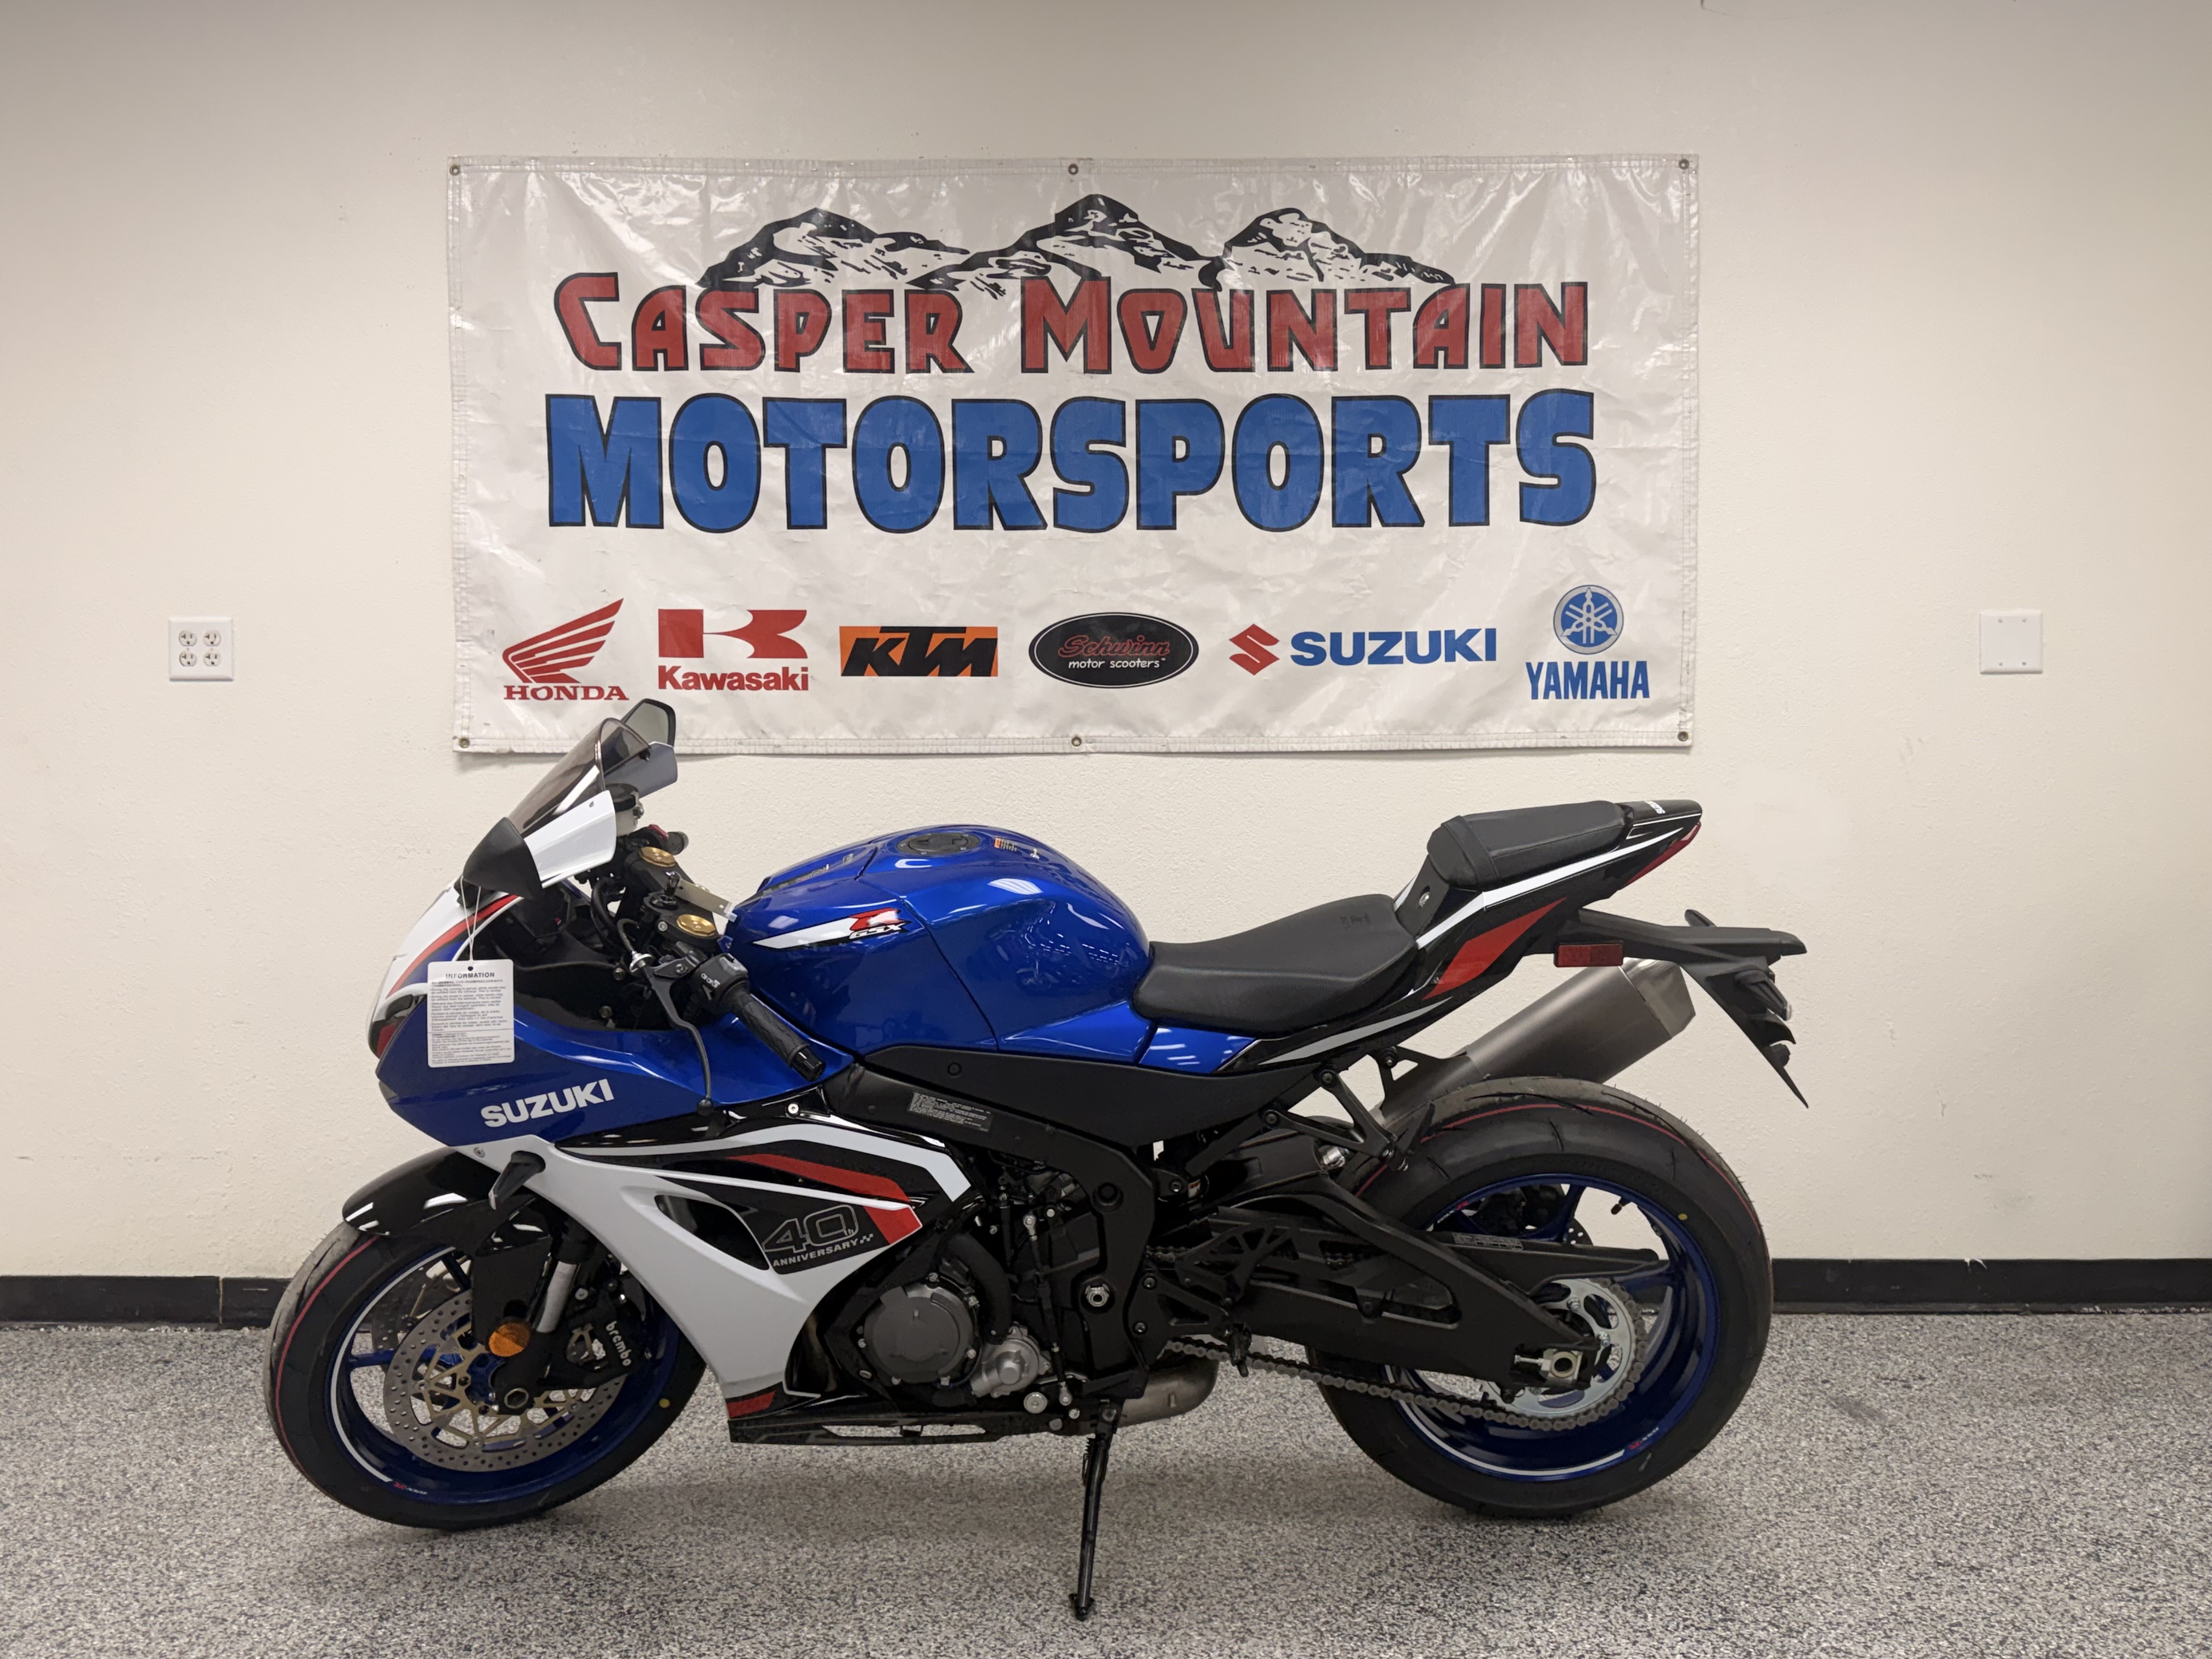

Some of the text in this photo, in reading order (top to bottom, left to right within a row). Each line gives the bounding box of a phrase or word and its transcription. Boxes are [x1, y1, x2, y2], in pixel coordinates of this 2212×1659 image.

[555, 273, 1589, 374] CASPER MOUNTAIN
[546, 388, 1596, 534] MOTORSPORTS
[840, 626, 998, 677] KTM
[1058, 635, 1170, 657] Schwinn
[1068, 658, 1105, 668] motor
[1291, 628, 1497, 666] SUZUKI
[505, 685, 629, 701] HONDA
[658, 665, 809, 691] Kawasaki
[1526, 661, 1650, 699] YAMAHA
[481, 1079, 614, 1127] SUZUKI
[772, 1238, 858, 1267] ANNIVERSARY
[606, 1321, 632, 1366] brembo
